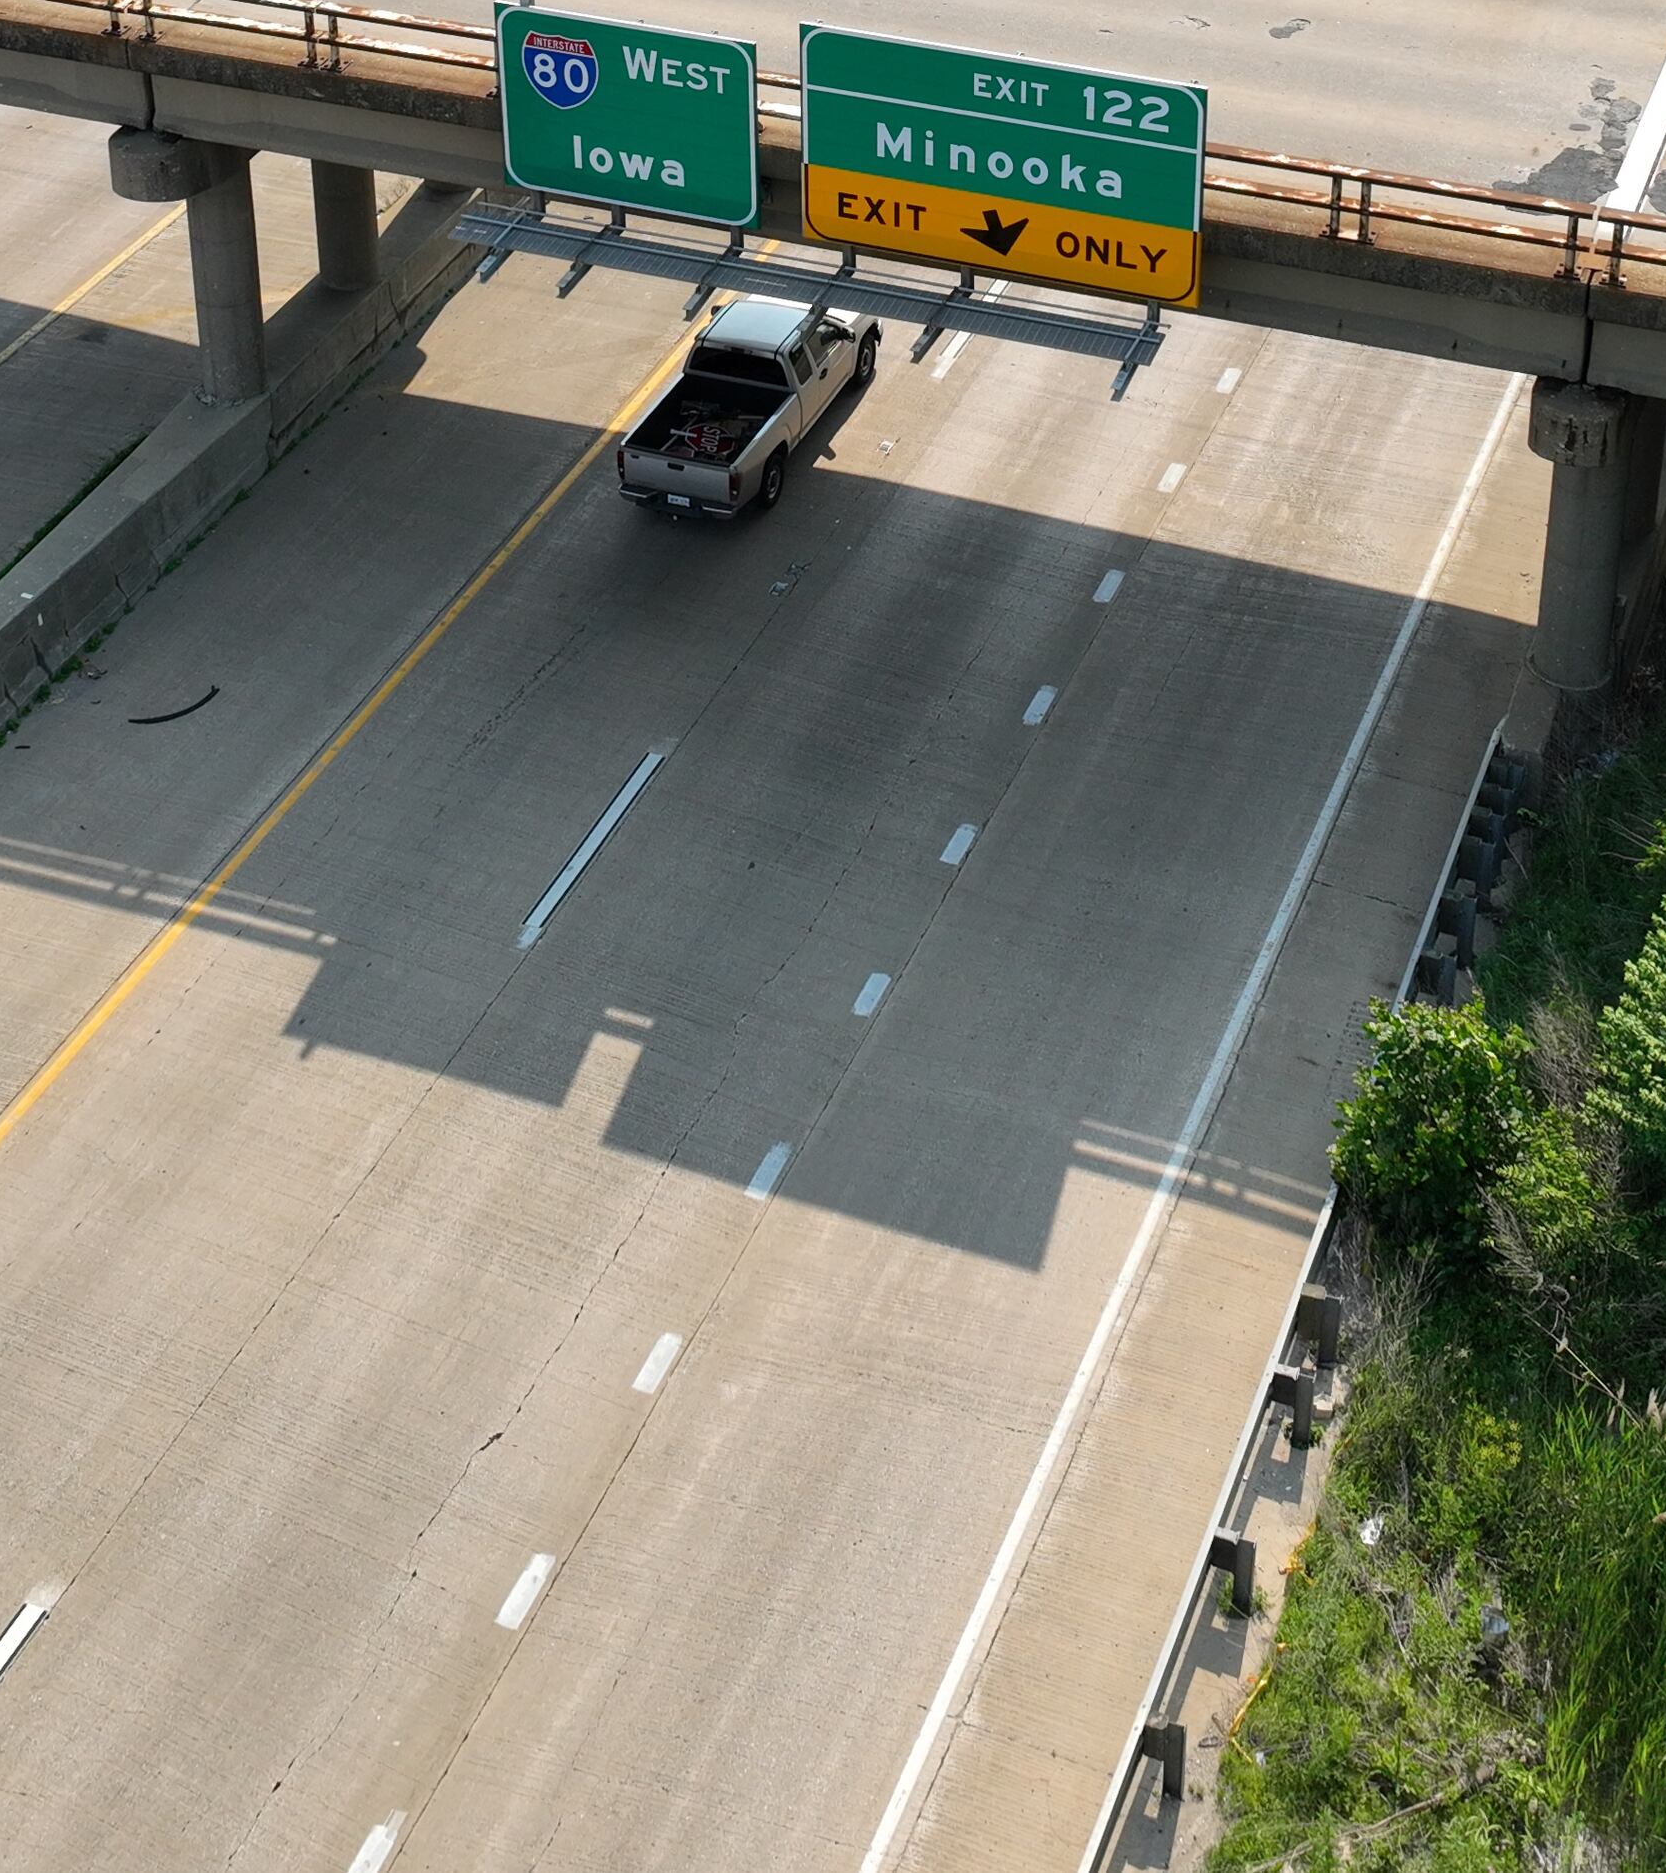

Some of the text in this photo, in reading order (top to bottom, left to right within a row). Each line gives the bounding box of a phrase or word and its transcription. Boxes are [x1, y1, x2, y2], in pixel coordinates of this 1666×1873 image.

[532, 36, 586, 55] INTERSTATE
[622, 45, 730, 95] WEST
[532, 54, 590, 94] 80
[973, 72, 1169, 133] EXIT 122
[572, 135, 685, 187] Iowa
[876, 122, 1123, 198] Minooka
[837, 192, 1167, 273] EXIT ONLY
[700, 426, 721, 453] STOP
